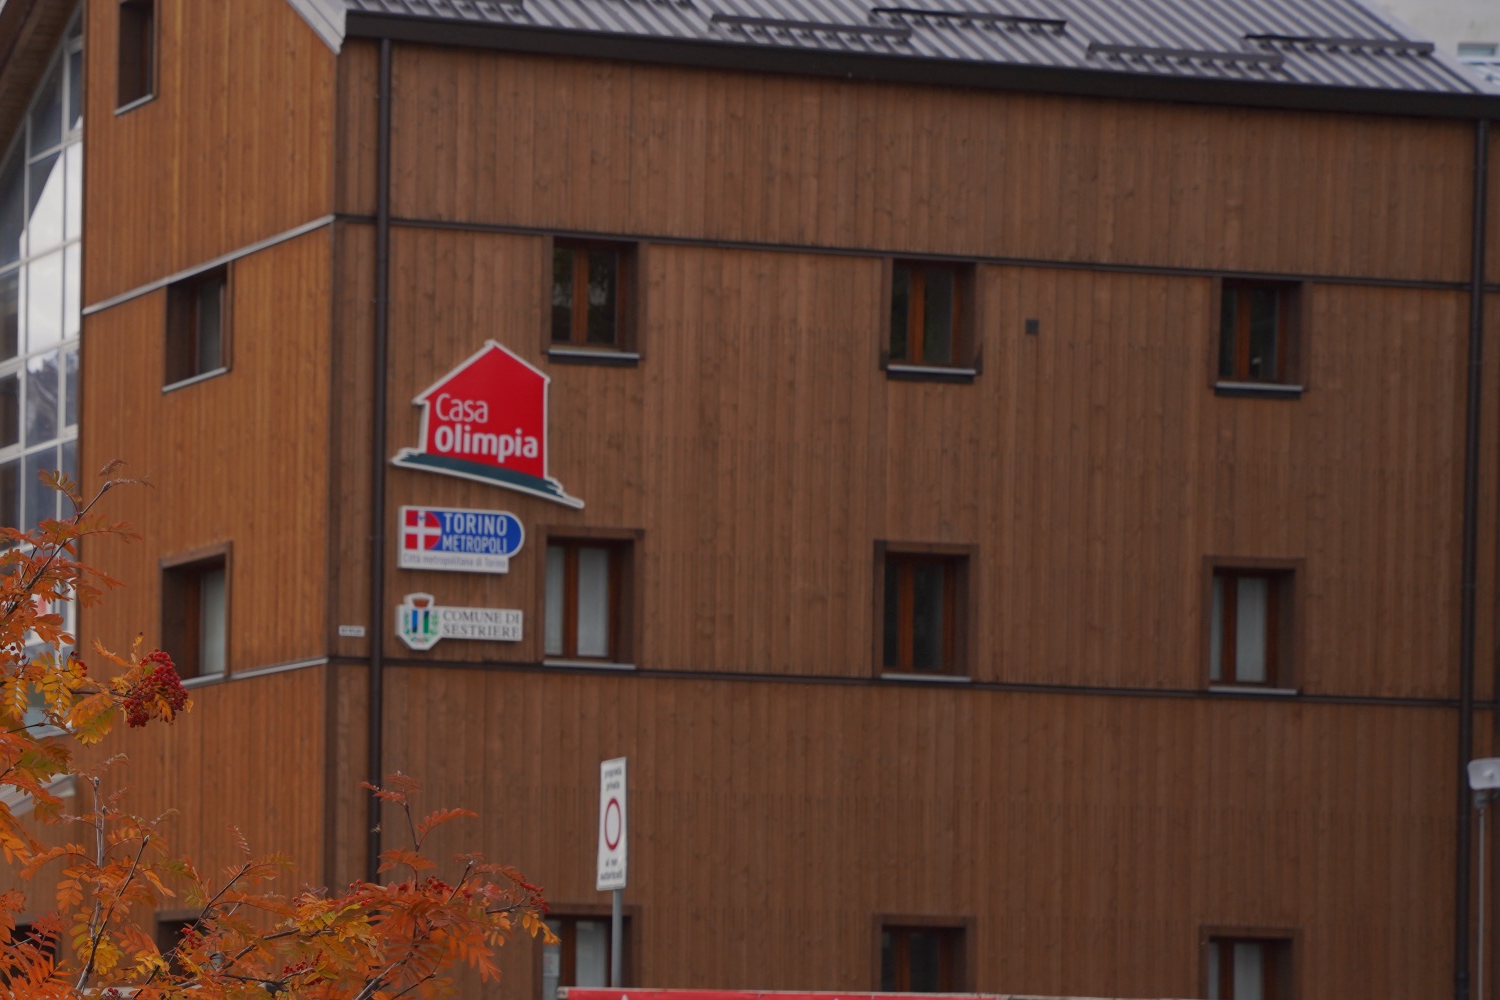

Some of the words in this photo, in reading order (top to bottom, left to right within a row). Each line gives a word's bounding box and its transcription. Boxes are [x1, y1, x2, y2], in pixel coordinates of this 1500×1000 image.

[435, 392, 489, 424] Casa
[434, 423, 539, 464] Olimpia
[443, 512, 508, 537] TORINO
[442, 534, 508, 554] METROPOLI
[443, 609, 500, 624] COMUNE
[505, 611, 520, 625] DI
[443, 623, 520, 637] SESTRIERE
